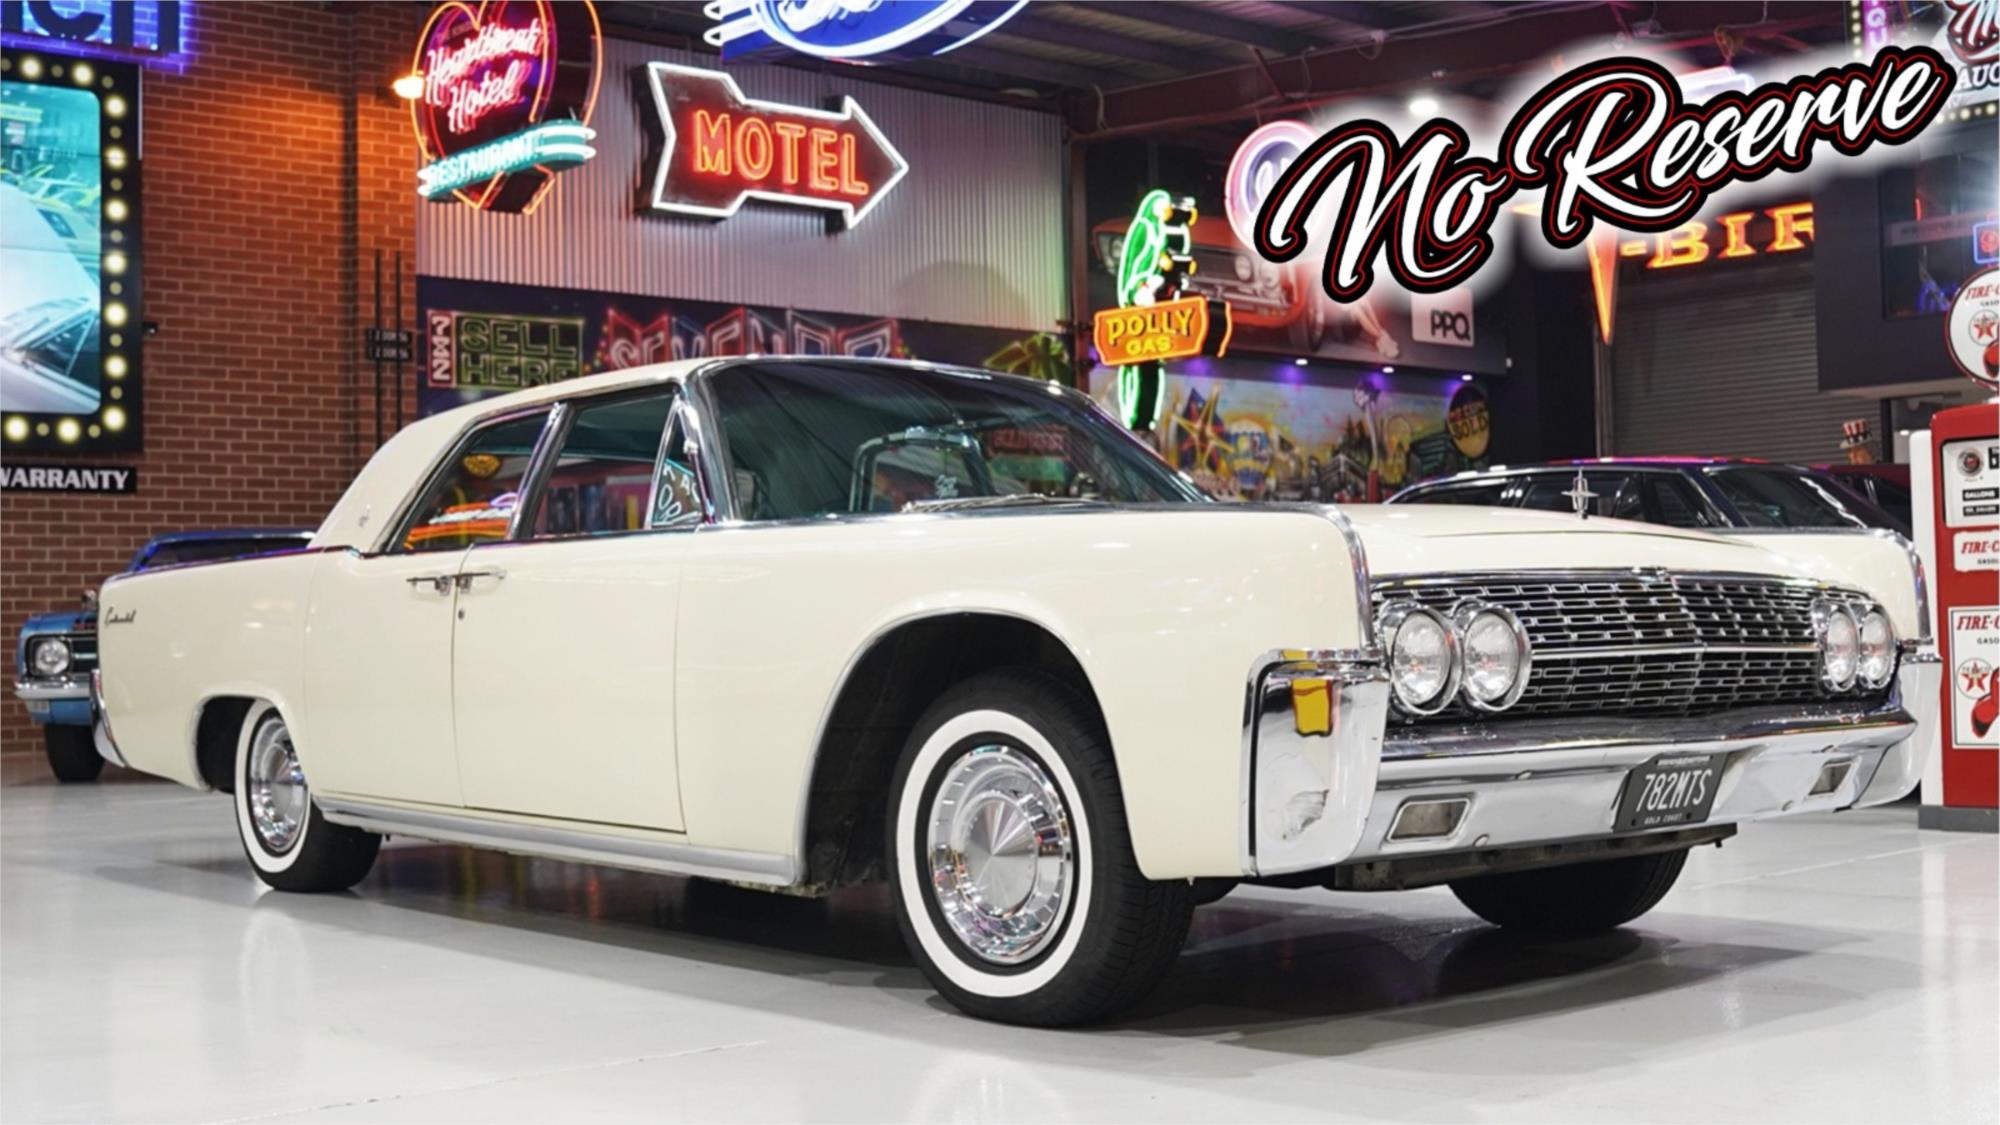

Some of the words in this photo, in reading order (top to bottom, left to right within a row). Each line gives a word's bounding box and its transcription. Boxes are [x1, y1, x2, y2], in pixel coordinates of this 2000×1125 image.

[447, 59, 523, 133] Hotel
[427, 129, 535, 190] RESTAURANT
[694, 109, 869, 196] MOTEL
[461, 318, 577, 358] SELL
[1106, 307, 1193, 346] POLLY
[1431, 309, 1470, 341] PPQ
[1126, 336, 1171, 356] GAS
[460, 352, 577, 385] HERE
[1636, 769, 1712, 812] 782MTS
